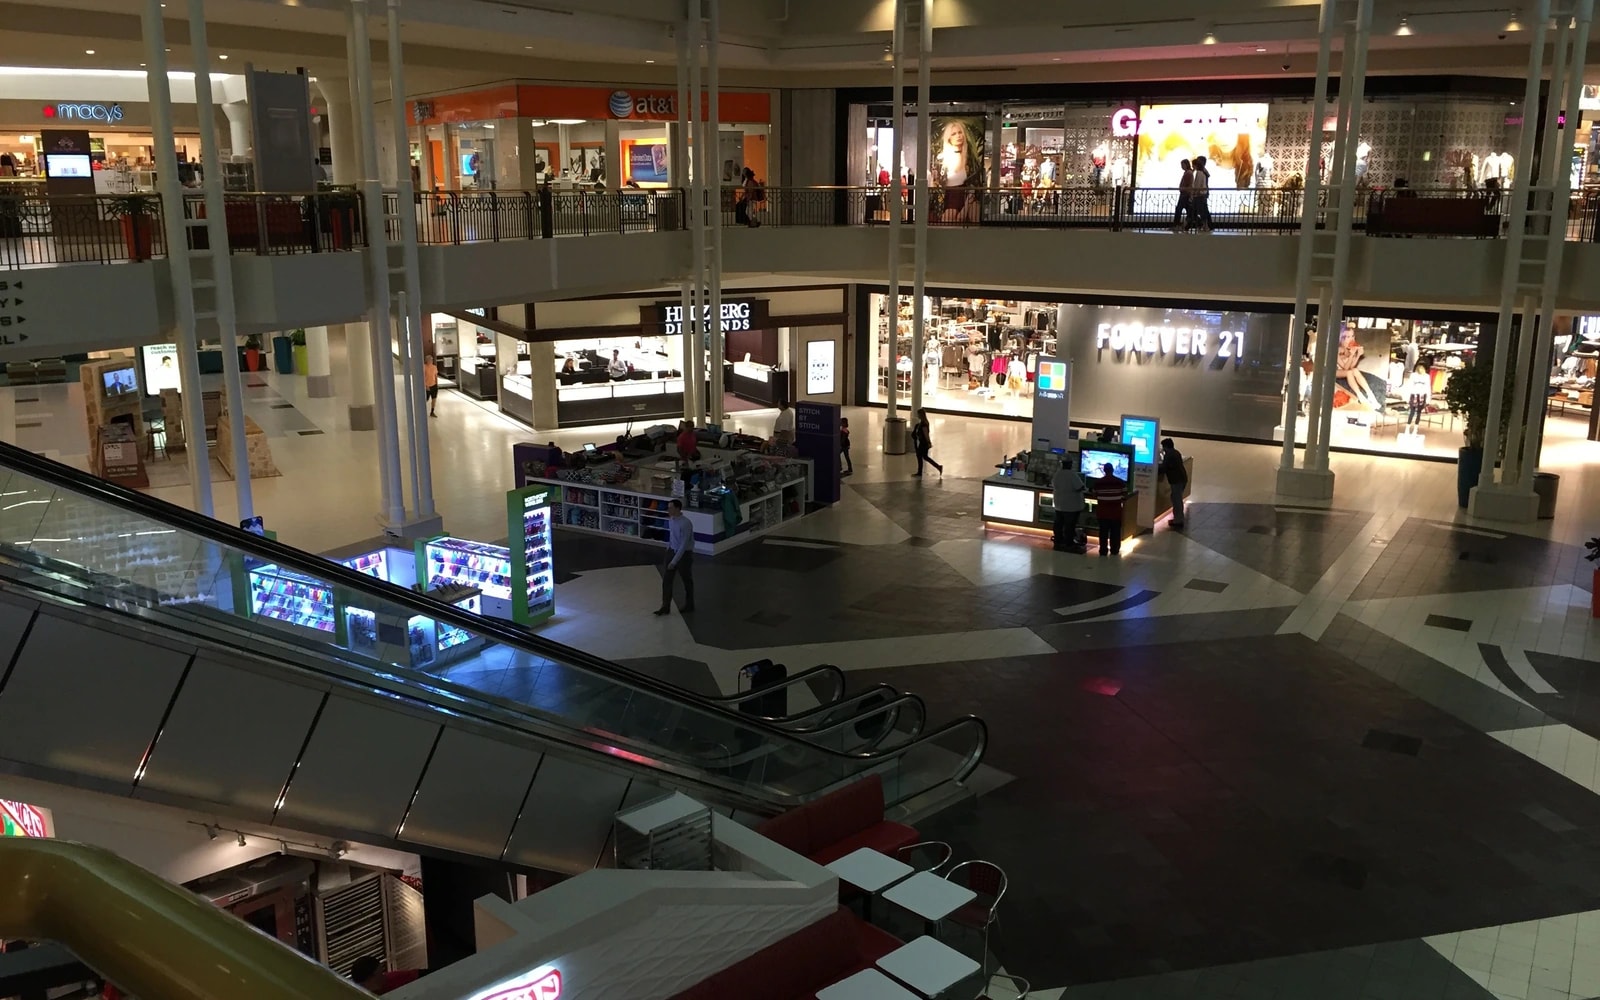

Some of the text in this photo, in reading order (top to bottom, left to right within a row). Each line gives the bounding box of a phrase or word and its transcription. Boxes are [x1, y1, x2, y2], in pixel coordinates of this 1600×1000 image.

[635, 96, 678, 114] at&t
[1097, 323, 1245, 358] FOREVER 21
[799, 421, 820, 430] STITCH
